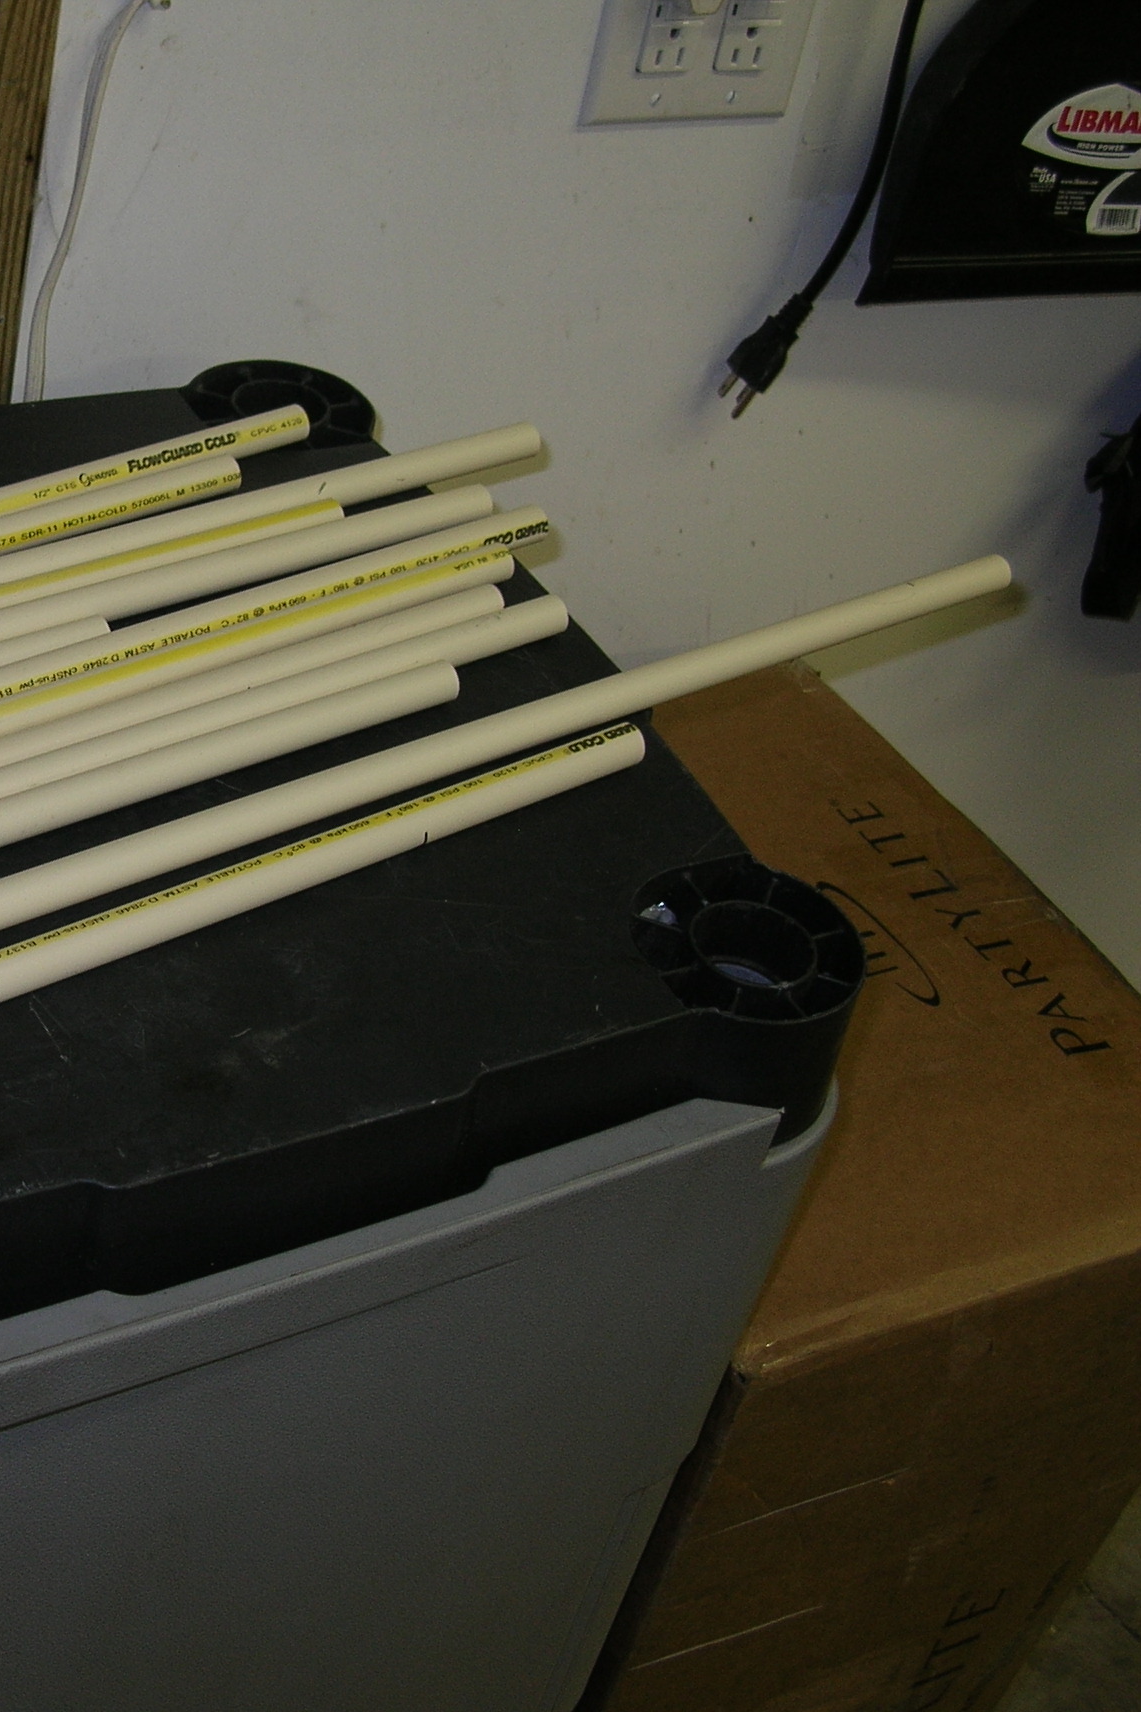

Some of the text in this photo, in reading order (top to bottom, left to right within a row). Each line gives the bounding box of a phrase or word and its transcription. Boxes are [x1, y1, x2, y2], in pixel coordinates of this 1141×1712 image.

[1057, 106, 1141, 134] LIBMA
[1038, 173, 1057, 183] USA
[56, 482, 77, 493] CTS
[79, 468, 118, 487] Genova
[250, 426, 277, 438] CPVC
[21, 524, 58, 541] SDR-11
[176, 488, 185, 496] M
[441, 545, 470, 559] CPVC
[416, 555, 440, 566] 4120
[453, 560, 474, 570] USA
[390, 564, 407, 575] 100
[370, 571, 387, 582] PSI
[269, 601, 287, 612] kPa
[289, 595, 307, 607] 690
[161, 625, 211, 648] POTABLE
[111, 652, 120, 661] D
[124, 641, 155, 660] ASTM
[82, 656, 109, 672] 2846
[463, 779, 483, 789] 100
[207, 859, 263, 884] POTABLE
[162, 881, 199, 899] ASTM
[148, 896, 159, 904] D
